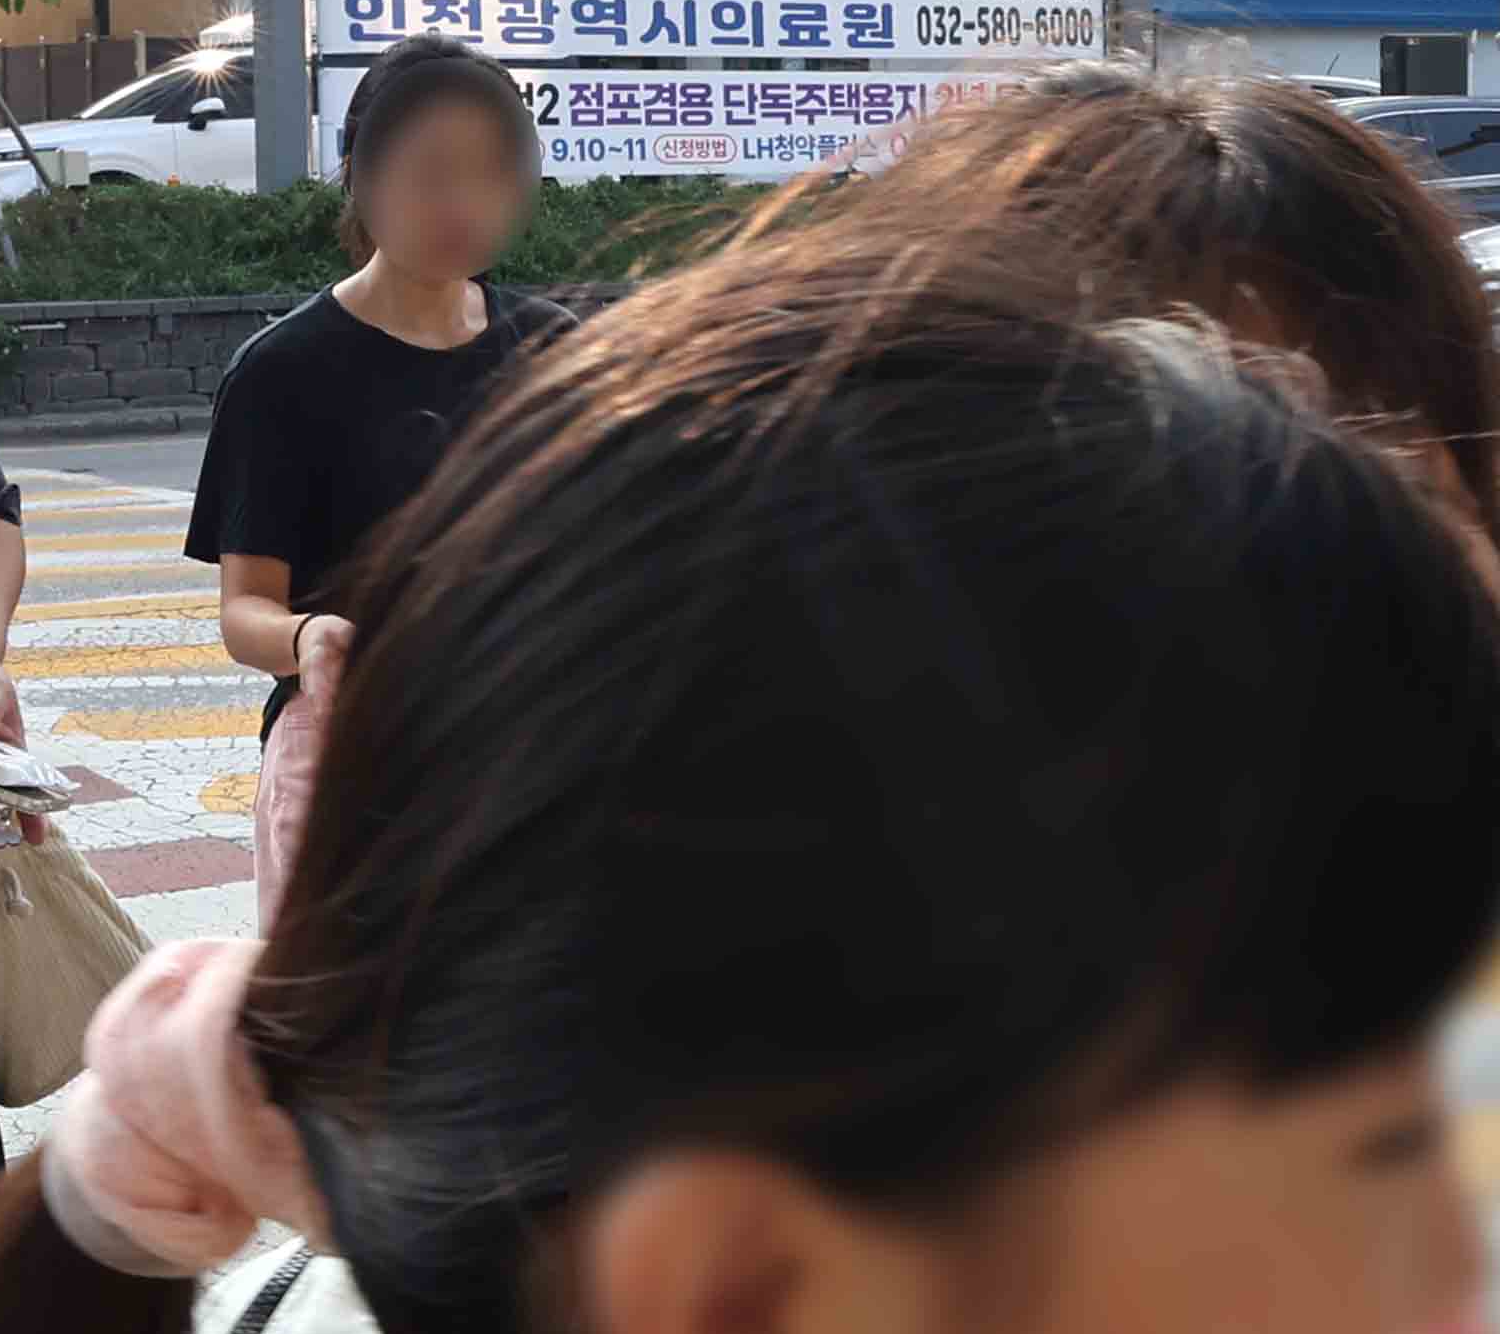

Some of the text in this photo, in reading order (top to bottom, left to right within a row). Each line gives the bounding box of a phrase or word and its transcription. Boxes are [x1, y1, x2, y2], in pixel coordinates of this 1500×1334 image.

[916, 5, 1094, 48] 032-580-6000
[568, 82, 714, 128] 점포겸용
[722, 82, 927, 128] 단독주택용지
[550, 136, 647, 163] 9.10~11
[661, 138, 729, 159] 신청방법
